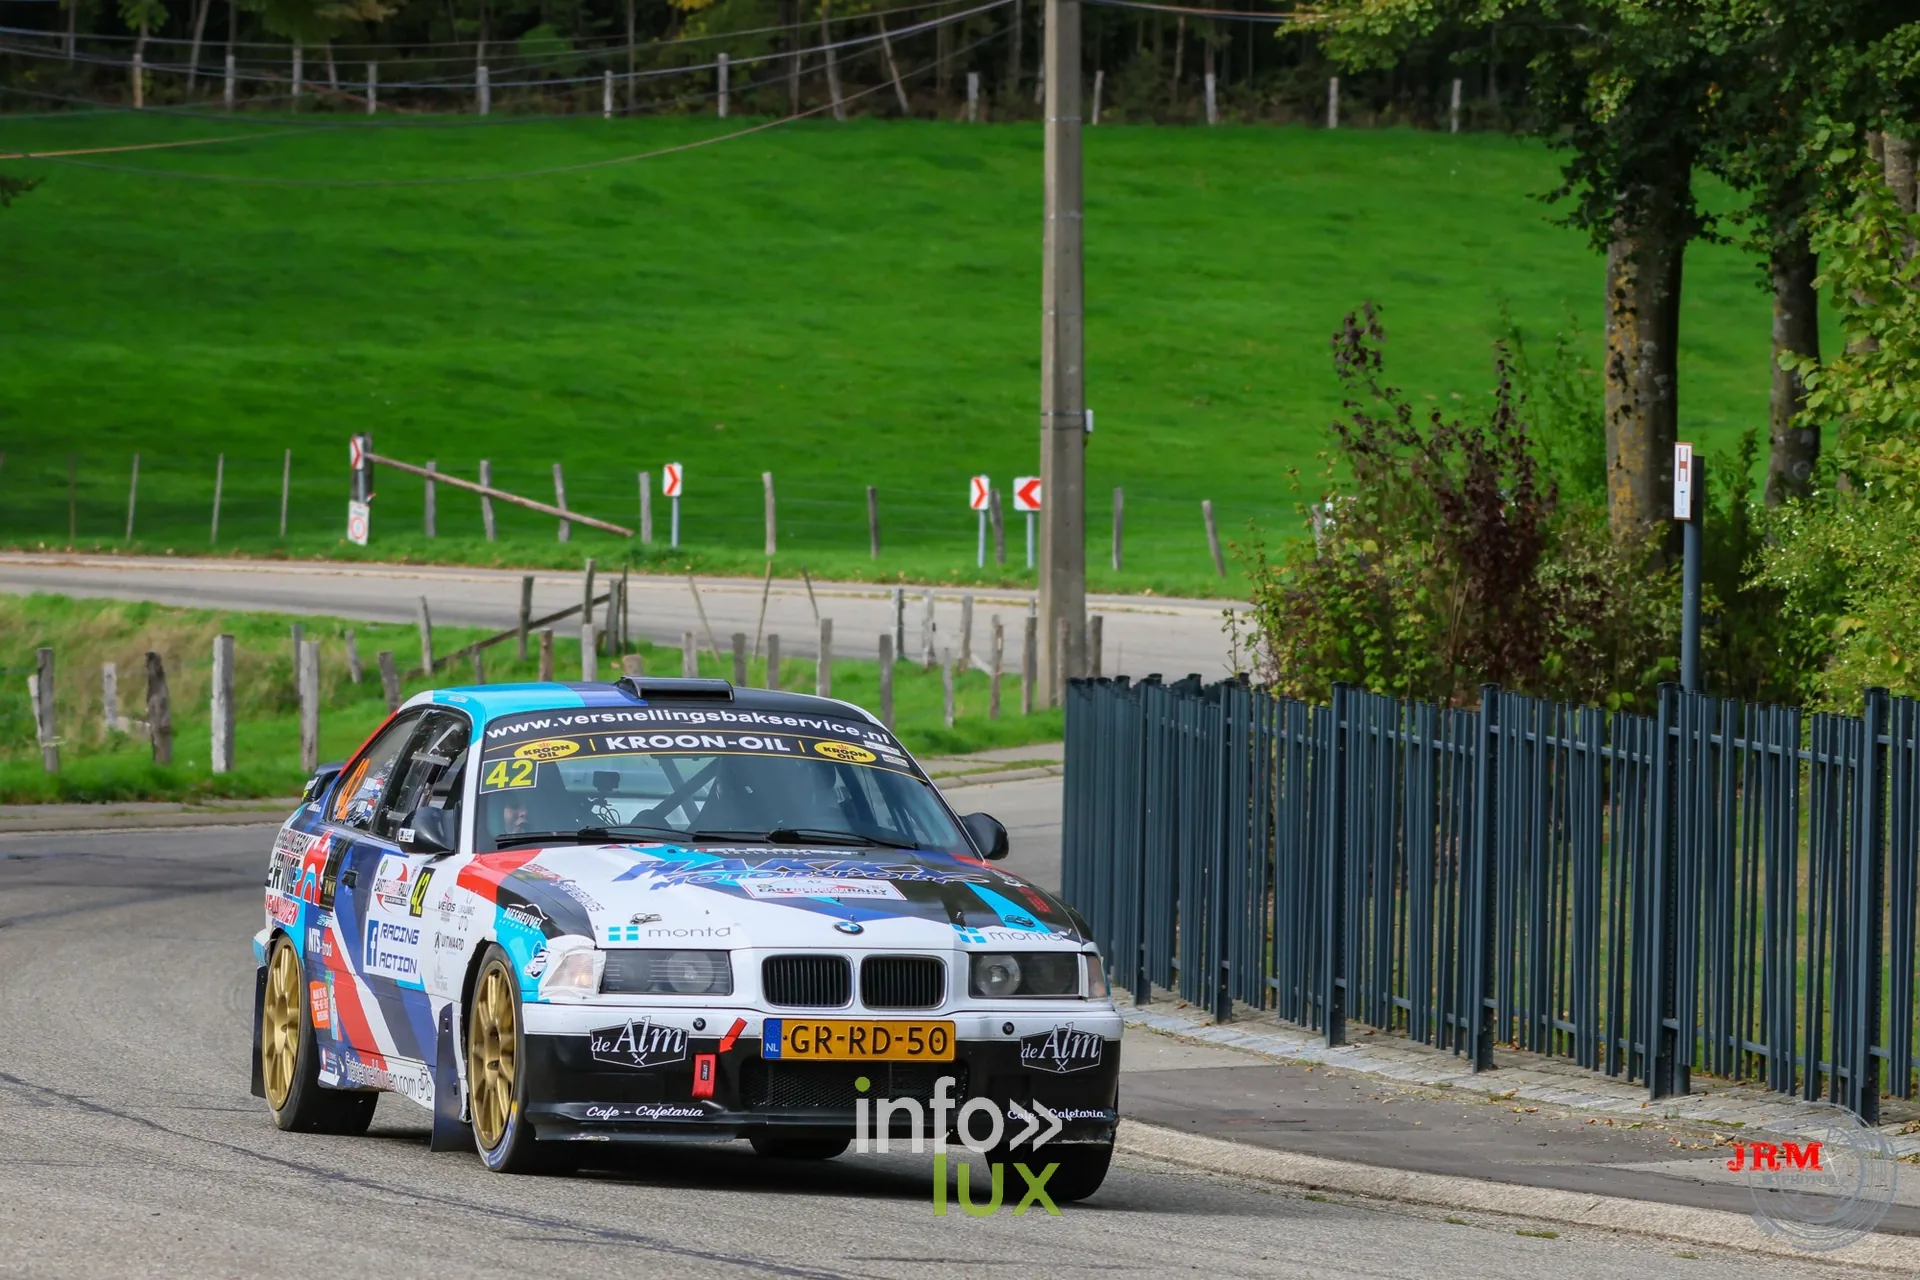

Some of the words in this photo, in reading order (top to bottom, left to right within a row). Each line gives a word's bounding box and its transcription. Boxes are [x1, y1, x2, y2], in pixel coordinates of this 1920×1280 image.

[487, 709, 890, 745] www.versnellingsbakservice.nl
[523, 743, 571, 755] KROON
[537, 751, 559, 759] OIL
[606, 735, 790, 752] KROON-OIL
[822, 746, 867, 758] KROON
[837, 753, 857, 761] OIL
[485, 759, 534, 789] 42
[411, 872, 431, 915] 42
[503, 907, 543, 931] BIESHEUVEL
[380, 922, 420, 946] RACING
[648, 927, 731, 938] monta
[988, 930, 1065, 943] monta
[378, 951, 418, 974] ACTION
[591, 1037, 611, 1053] de
[611, 1015, 684, 1054] Alm
[765, 1043, 779, 1052] NL
[790, 1025, 948, 1056] GR-RD-50
[1020, 1044, 1038, 1059] de
[1037, 1022, 1100, 1059] Alm
[586, 1106, 620, 1121] Cafe
[635, 1105, 705, 1120] Cafetaria
